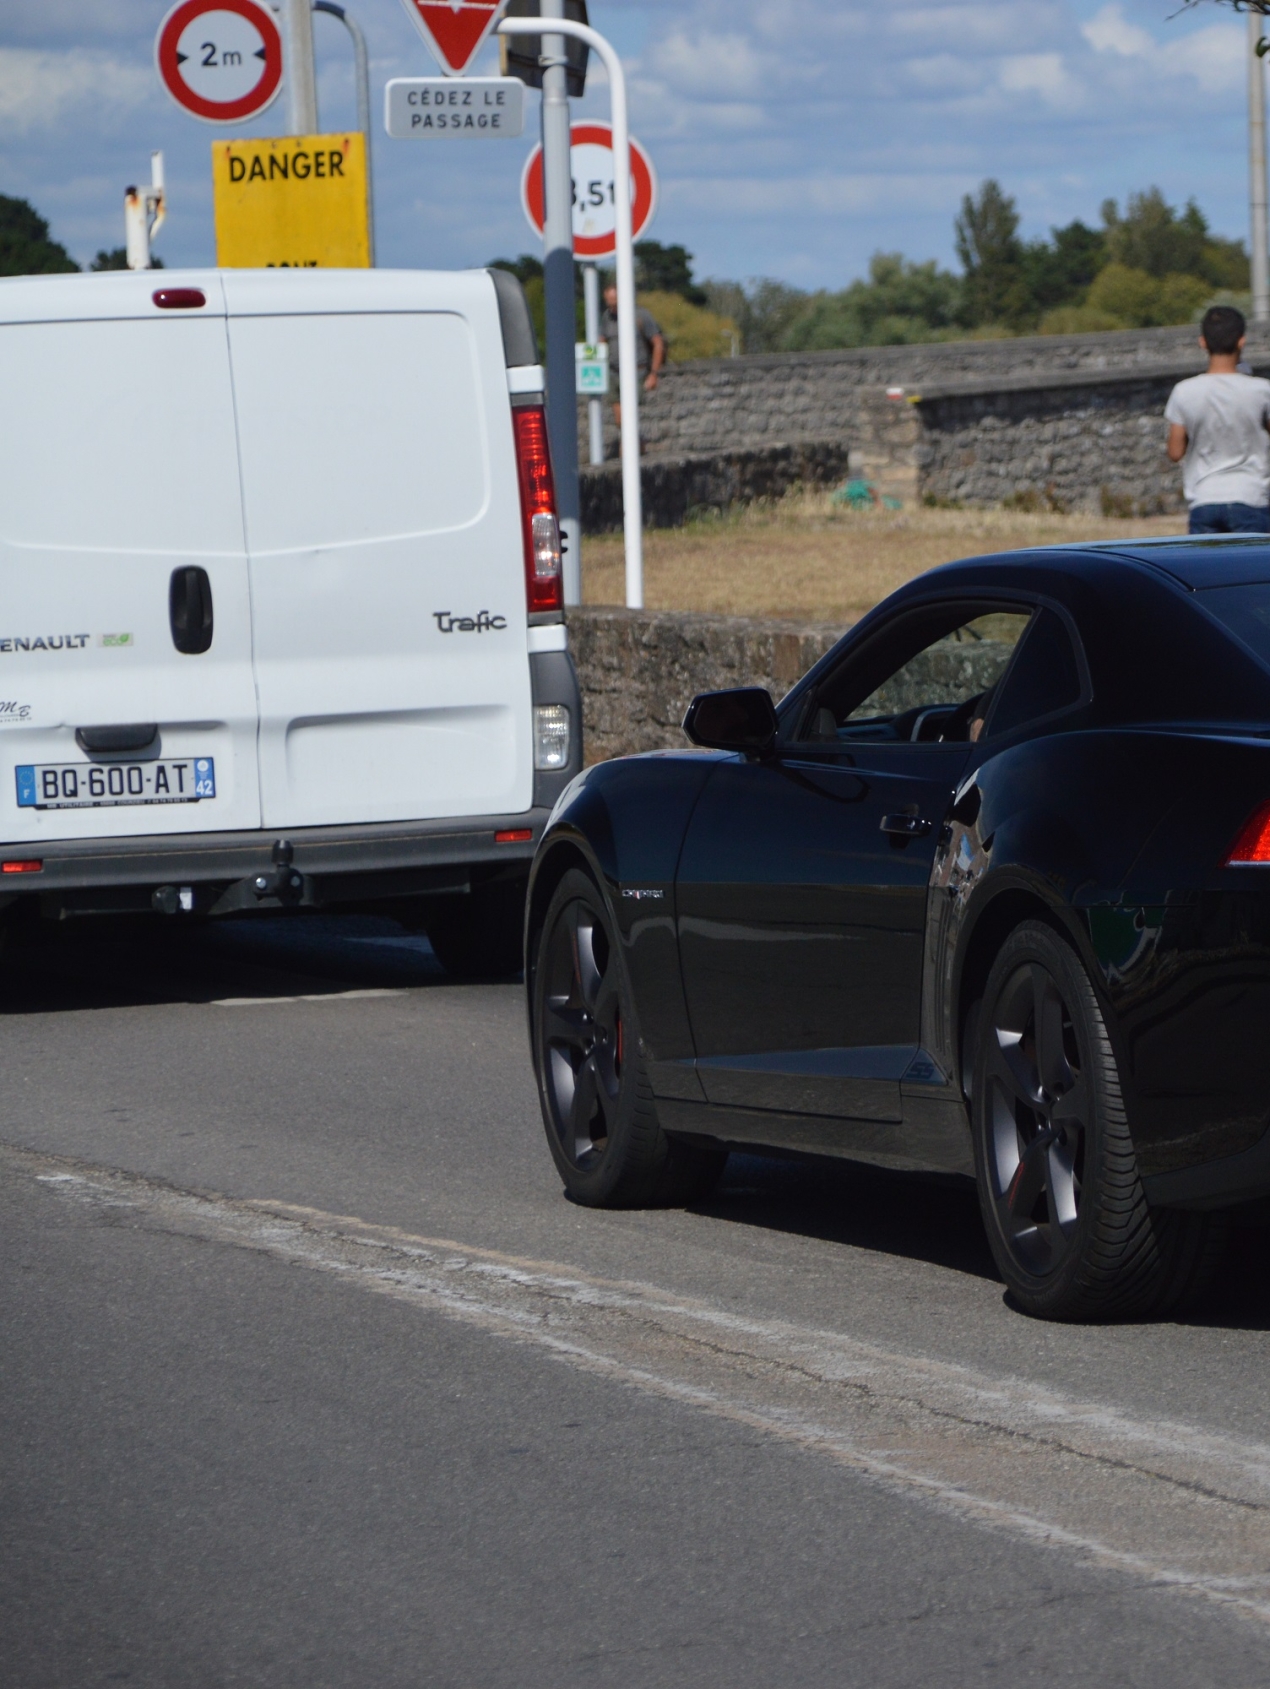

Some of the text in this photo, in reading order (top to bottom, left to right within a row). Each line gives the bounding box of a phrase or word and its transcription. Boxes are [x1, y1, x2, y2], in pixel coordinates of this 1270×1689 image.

[407, 88, 505, 105] CÉDEZ LE
[411, 114, 500, 128] PASSAGE
[229, 151, 345, 182] DANGER
[433, 610, 507, 633] Trafic
[0, 634, 90, 652] ENAULT
[42, 764, 187, 799] BQ-600-AT
[196, 780, 213, 796] 42
[23, 789, 30, 799] F
